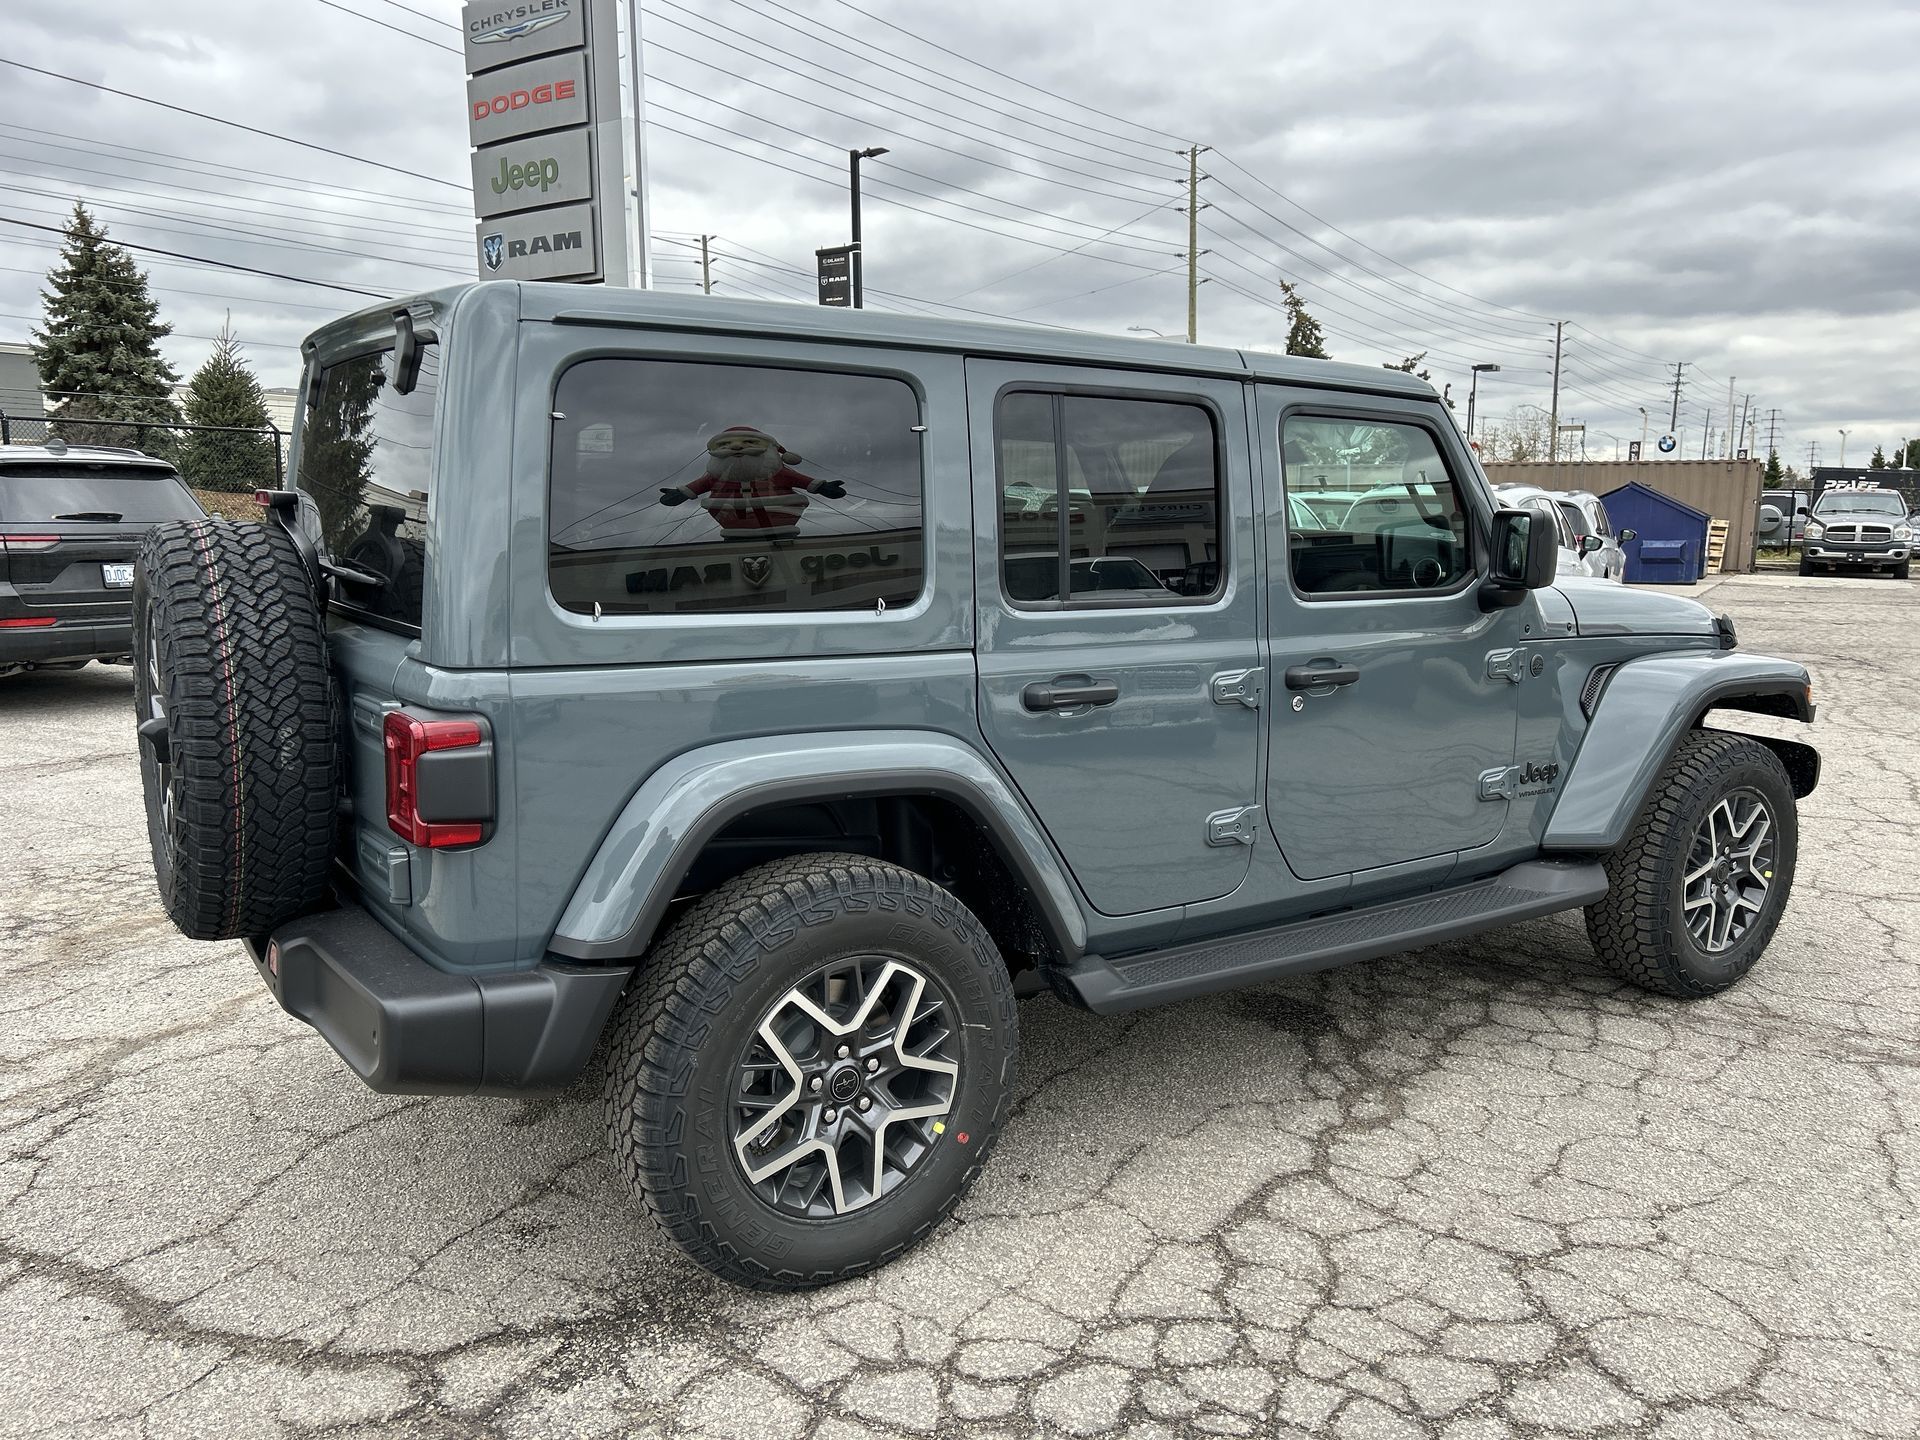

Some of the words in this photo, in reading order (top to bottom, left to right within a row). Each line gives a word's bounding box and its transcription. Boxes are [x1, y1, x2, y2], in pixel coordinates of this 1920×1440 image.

[470, 0, 569, 32] CHRYSLER
[474, 80, 576, 121] DODGE
[491, 157, 559, 194] Jeep
[508, 231, 582, 258] RAM
[1519, 761, 1559, 784] Jeep
[1518, 787, 1556, 798] WRANGLER
[887, 922, 994, 1050] GRABBER
[695, 1086, 794, 1260] GENERAL
